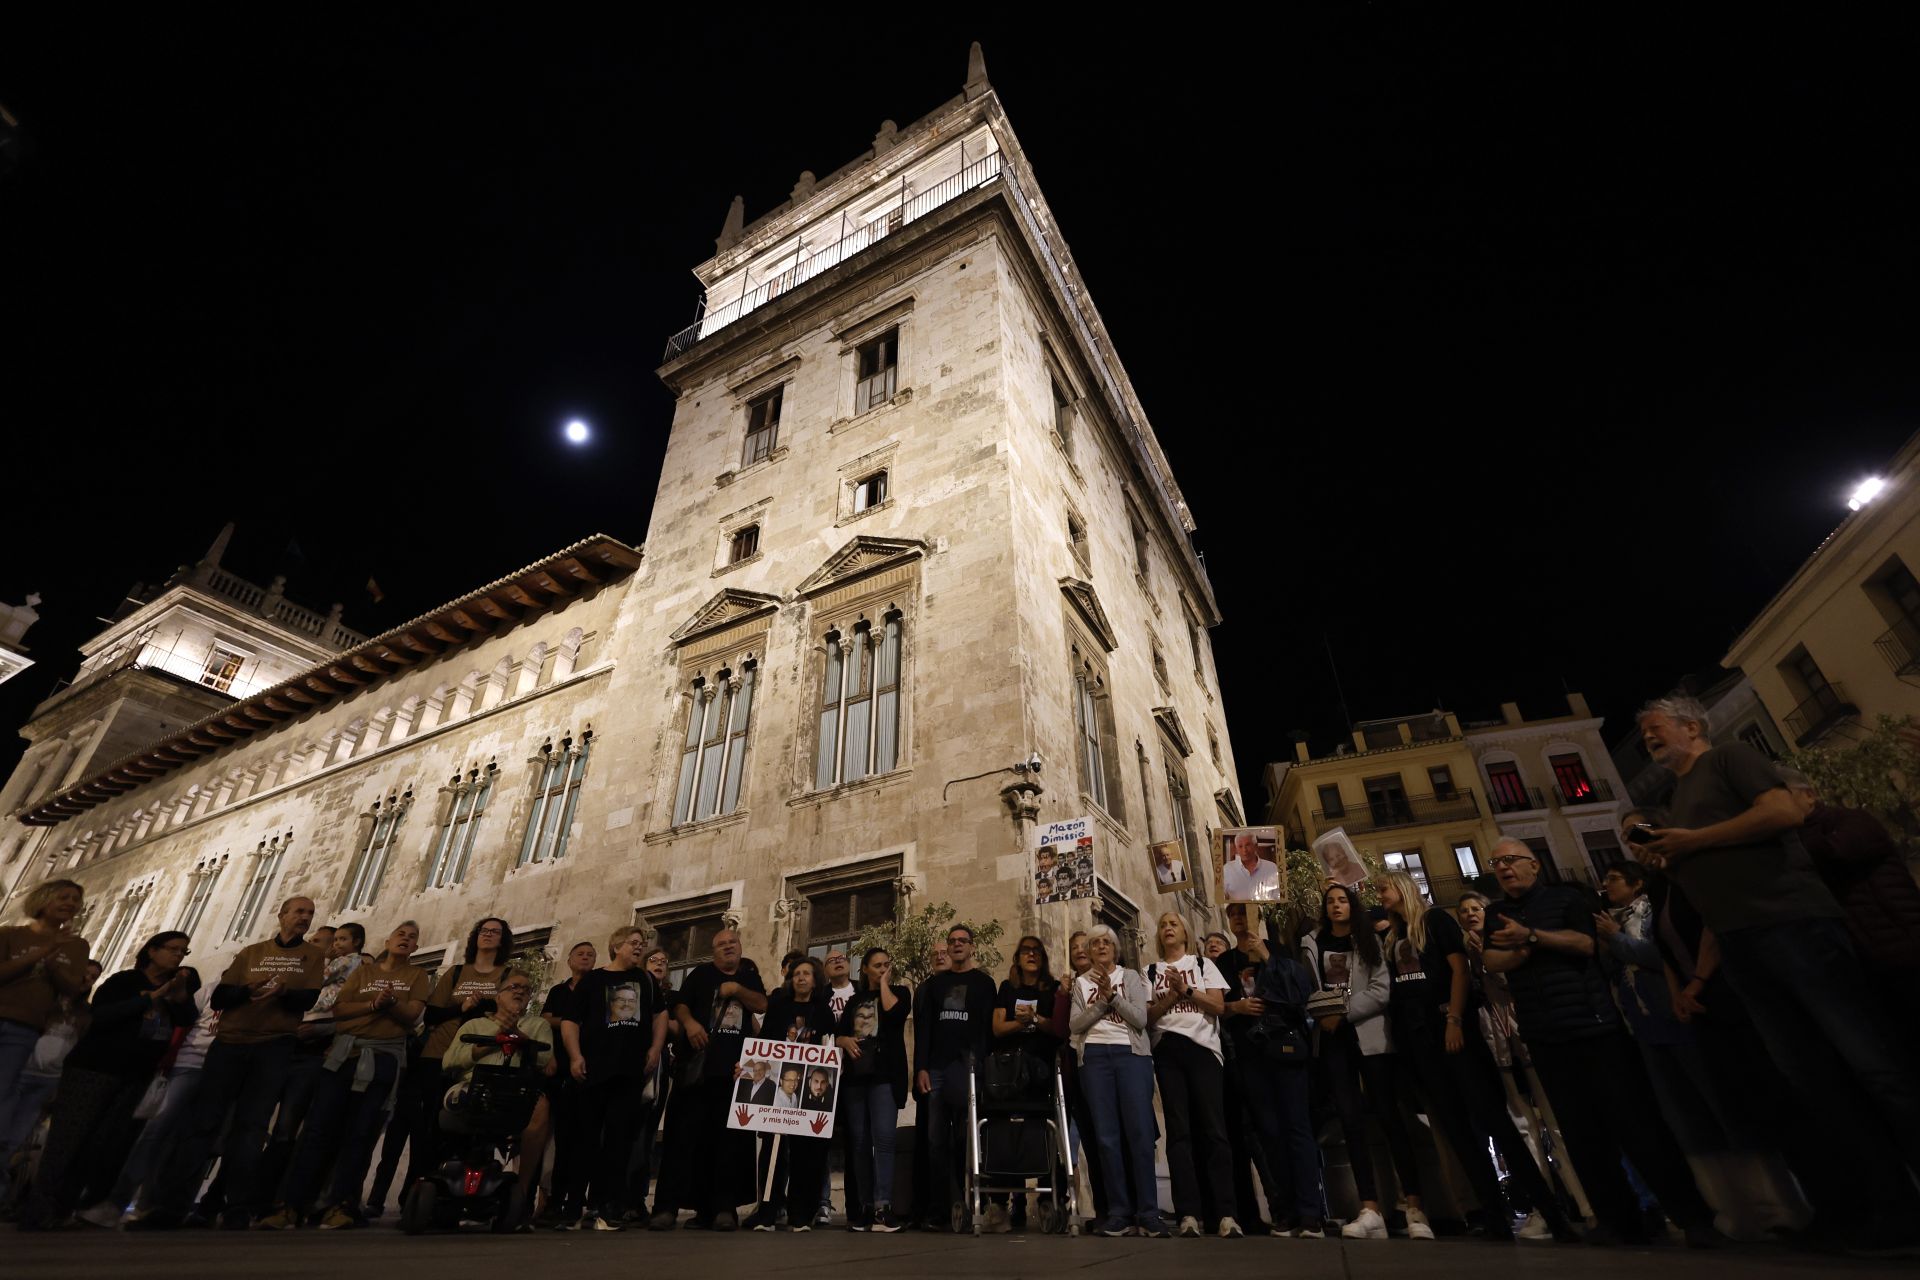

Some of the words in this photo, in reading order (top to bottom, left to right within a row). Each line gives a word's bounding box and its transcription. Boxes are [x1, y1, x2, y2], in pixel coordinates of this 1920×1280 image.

[1049, 818, 1086, 834] Mazón
[1041, 828, 1086, 845] Dimissió
[745, 1041, 840, 1066] JUSTICIA
[782, 1108, 807, 1117] marido
[782, 1117, 800, 1126] hijos
